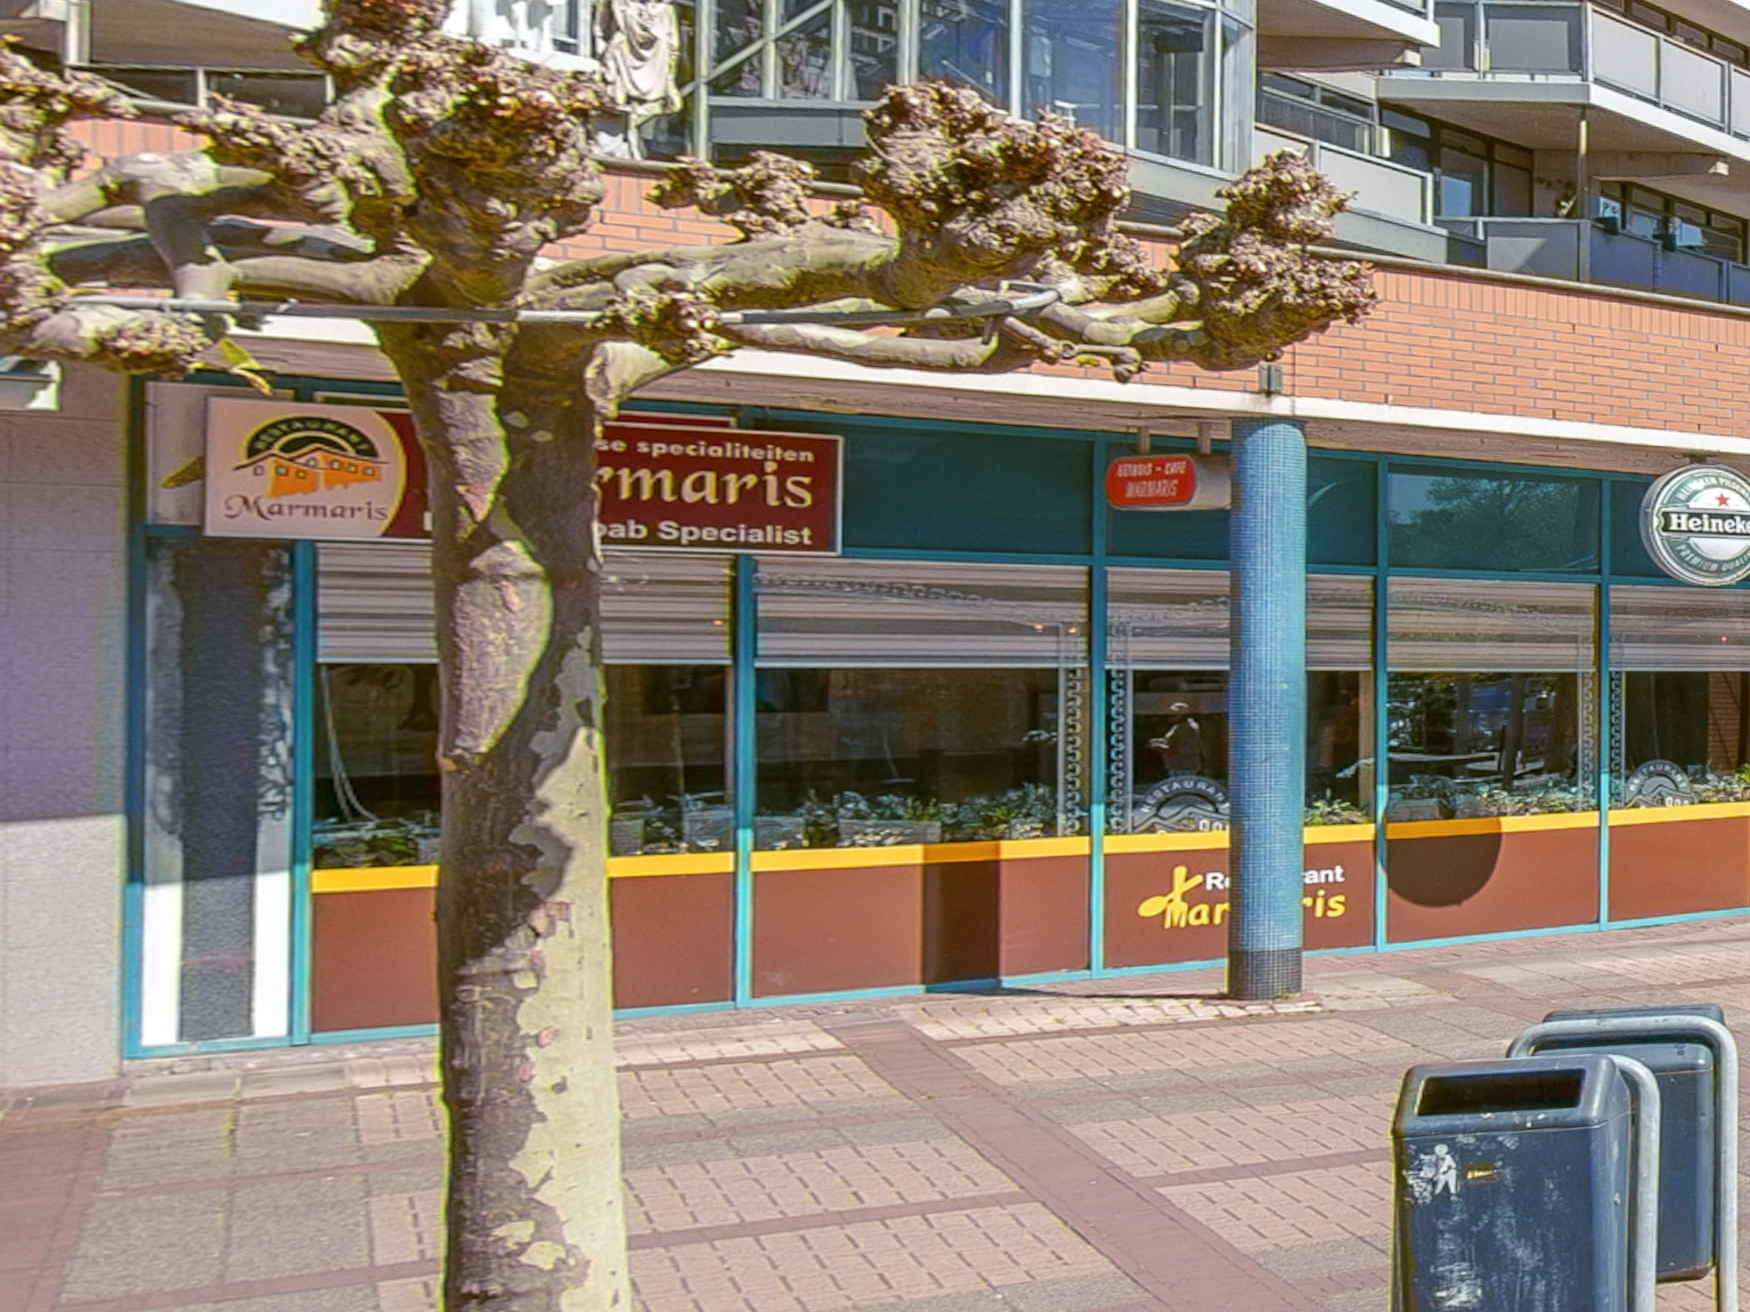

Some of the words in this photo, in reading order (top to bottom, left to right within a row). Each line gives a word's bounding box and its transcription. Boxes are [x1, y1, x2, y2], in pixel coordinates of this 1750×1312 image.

[636, 440, 815, 462] specialiteiten
[223, 494, 388, 521] Marmaris
[657, 520, 811, 545] Specialist
